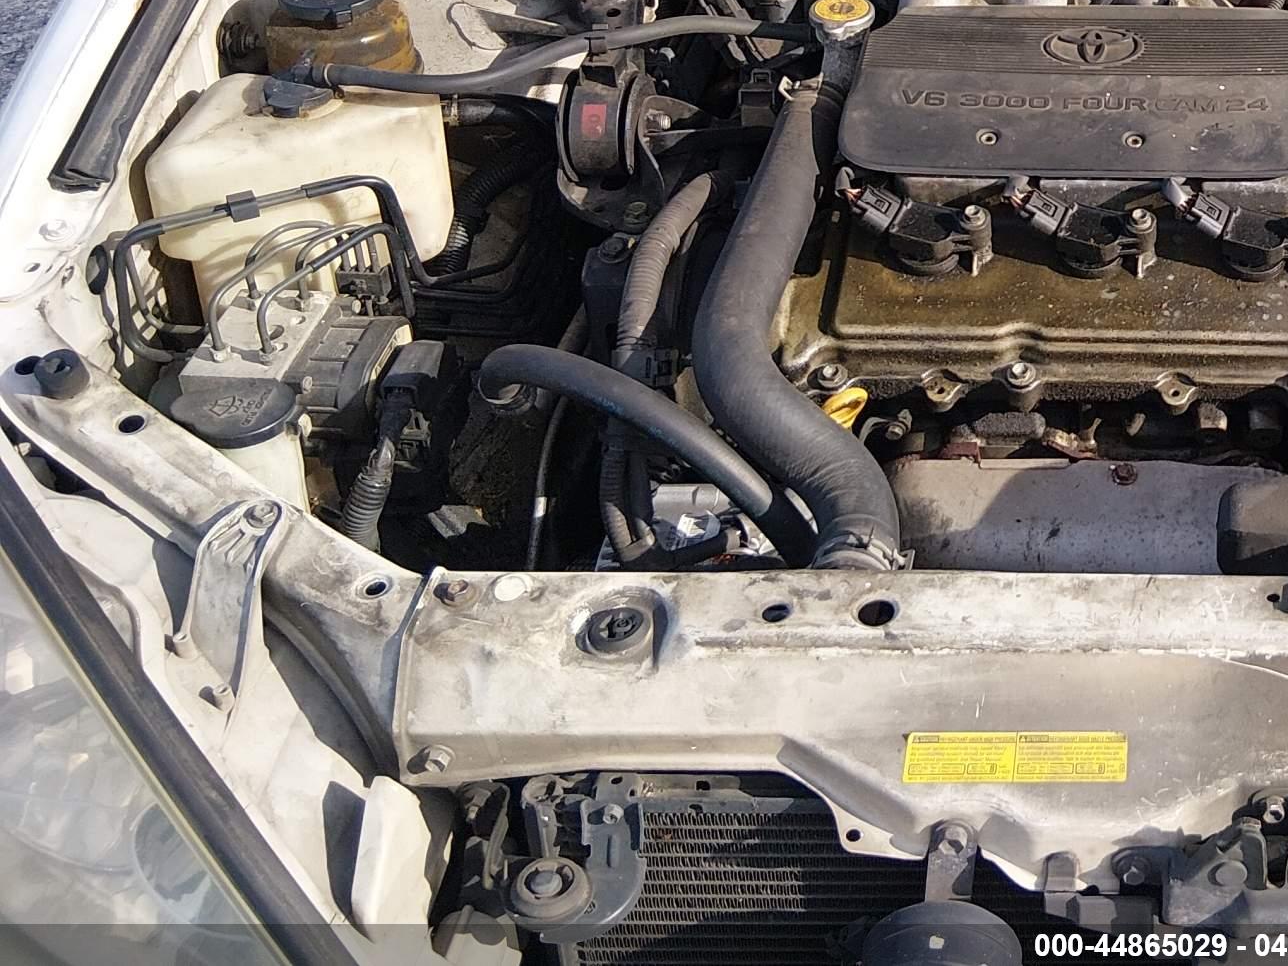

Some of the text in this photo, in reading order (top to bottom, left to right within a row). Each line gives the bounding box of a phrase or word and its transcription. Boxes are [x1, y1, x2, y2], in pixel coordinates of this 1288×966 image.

[900, 89, 1269, 114] V6 3000 FOUR CAM 24
